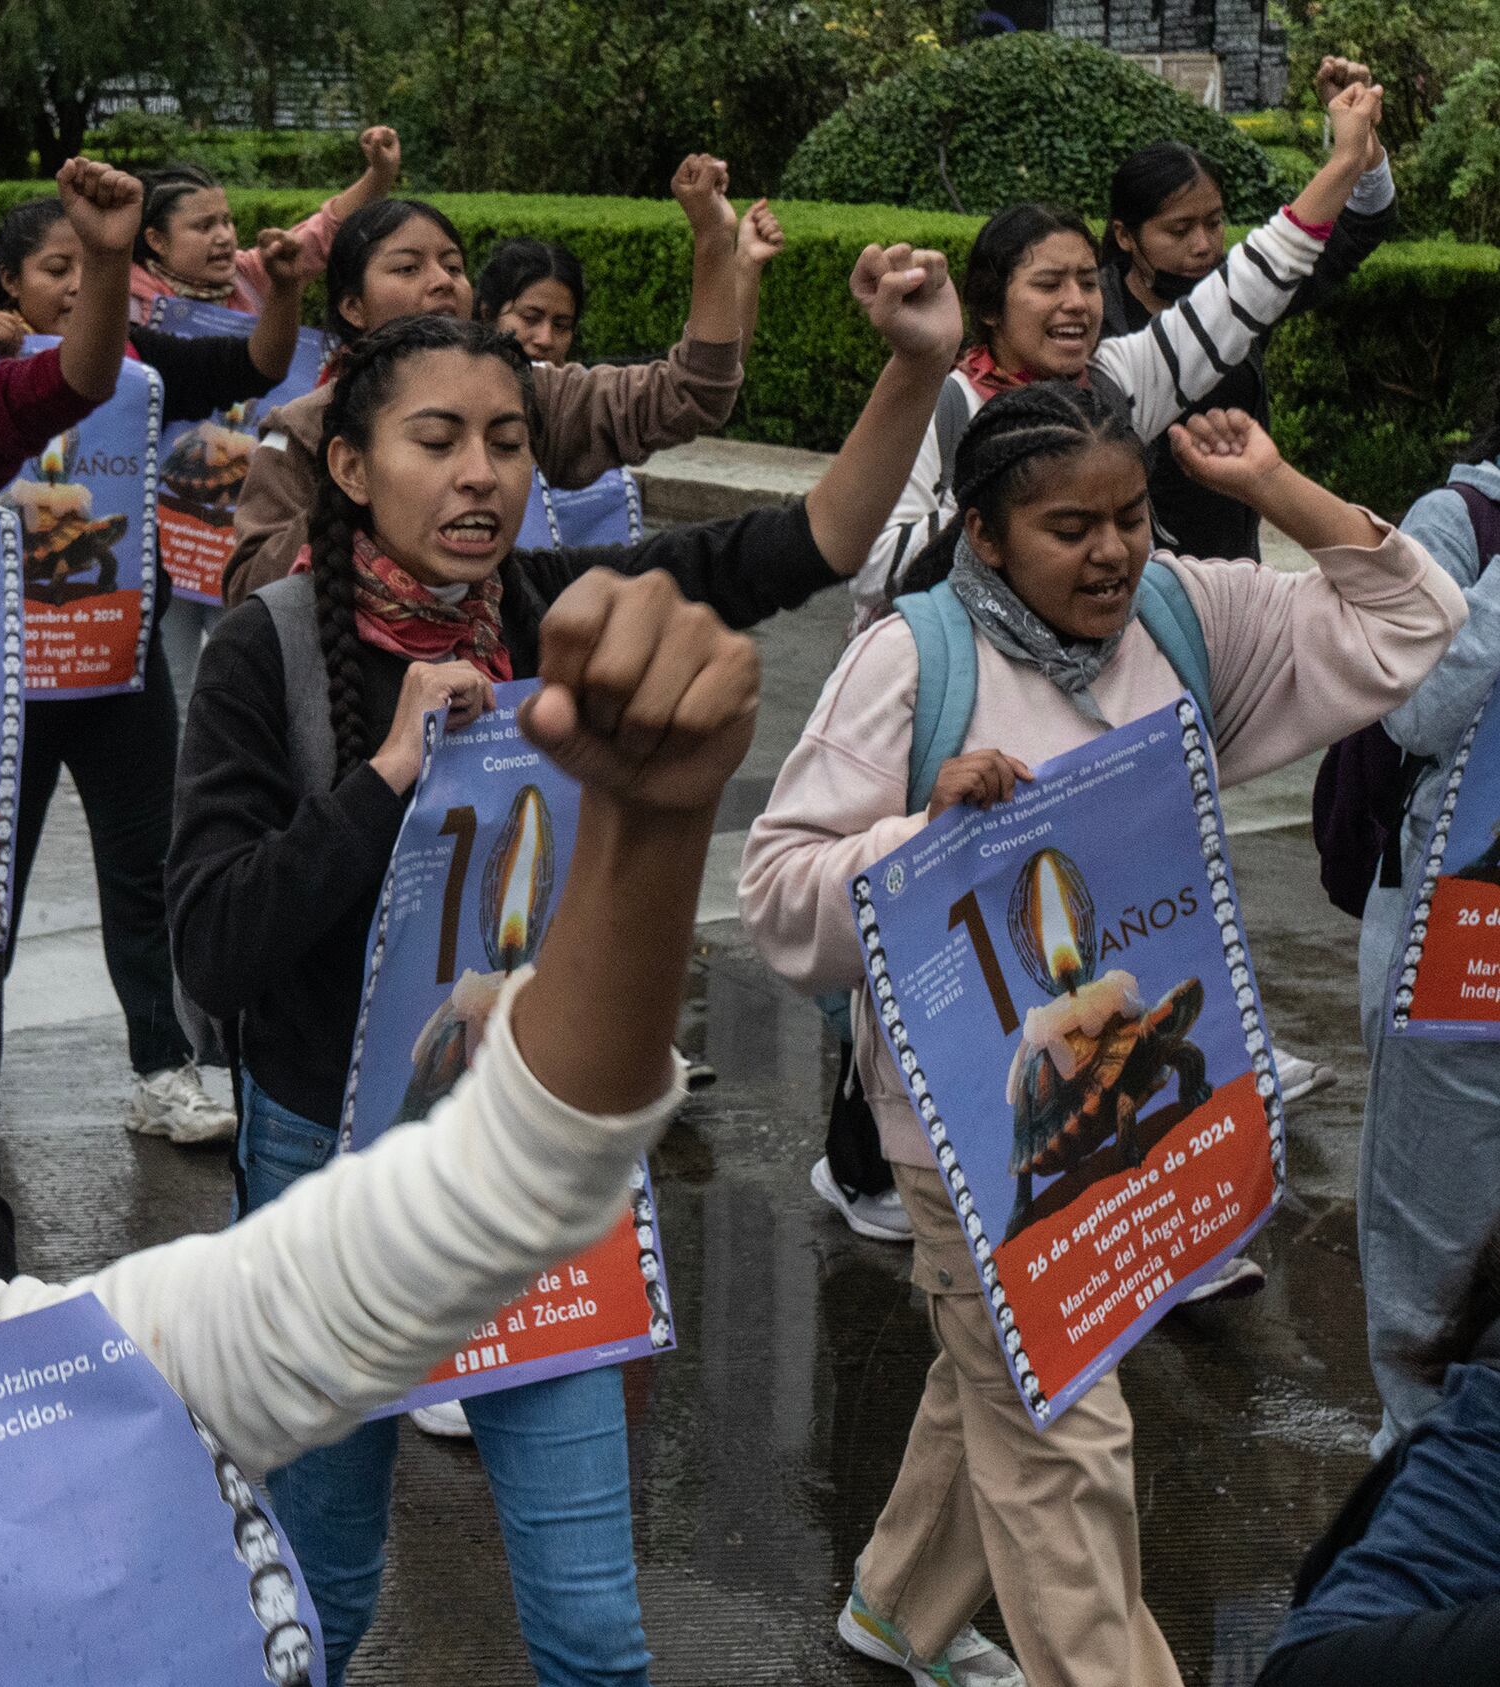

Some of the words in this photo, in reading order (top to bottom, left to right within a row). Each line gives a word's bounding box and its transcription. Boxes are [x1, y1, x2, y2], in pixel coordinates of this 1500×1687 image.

[75, 448, 138, 476] AÑOS
[73, 609, 90, 622] de
[81, 646, 95, 657] de
[475, 732, 489, 742] de
[491, 729, 504, 741] los
[482, 753, 540, 772] Convocan
[1014, 789, 1041, 805] Isidro
[1079, 765, 1091, 776] de
[1149, 730, 1168, 744] Gro.
[970, 825, 982, 838] de
[983, 820, 998, 831] los
[1000, 815, 1012, 825] 43
[1014, 794, 1065, 822] Estudiantes
[979, 820, 1052, 858] Convocan
[1101, 887, 1197, 960] AÑOS
[1457, 907, 1481, 926] 26
[1027, 1253, 1048, 1282] 26
[1050, 1237, 1070, 1262] de
[1071, 1168, 1160, 1243] septiembre
[1163, 1151, 1186, 1174] de
[1189, 1115, 1235, 1157] 2024
[1093, 1218, 1130, 1255] 16:00
[1131, 1189, 1176, 1226] Horas
[1059, 1268, 1110, 1319] Marcha
[1114, 1242, 1137, 1271] del
[1141, 1207, 1186, 1250] Ángel
[1191, 1195, 1212, 1216] de
[1216, 1181, 1234, 1199] la
[537, 1271, 562, 1293] de
[569, 1265, 589, 1288] la
[1066, 1254, 1164, 1345] Independencia
[1170, 1236, 1186, 1259] al
[1189, 1202, 1241, 1245] Zócalo
[1135, 1268, 1175, 1311] CDMX
[507, 1309, 527, 1333] al
[532, 1296, 597, 1327] Zócalo
[102, 1338, 139, 1364] Gro.
[454, 1342, 509, 1374] CDMX
